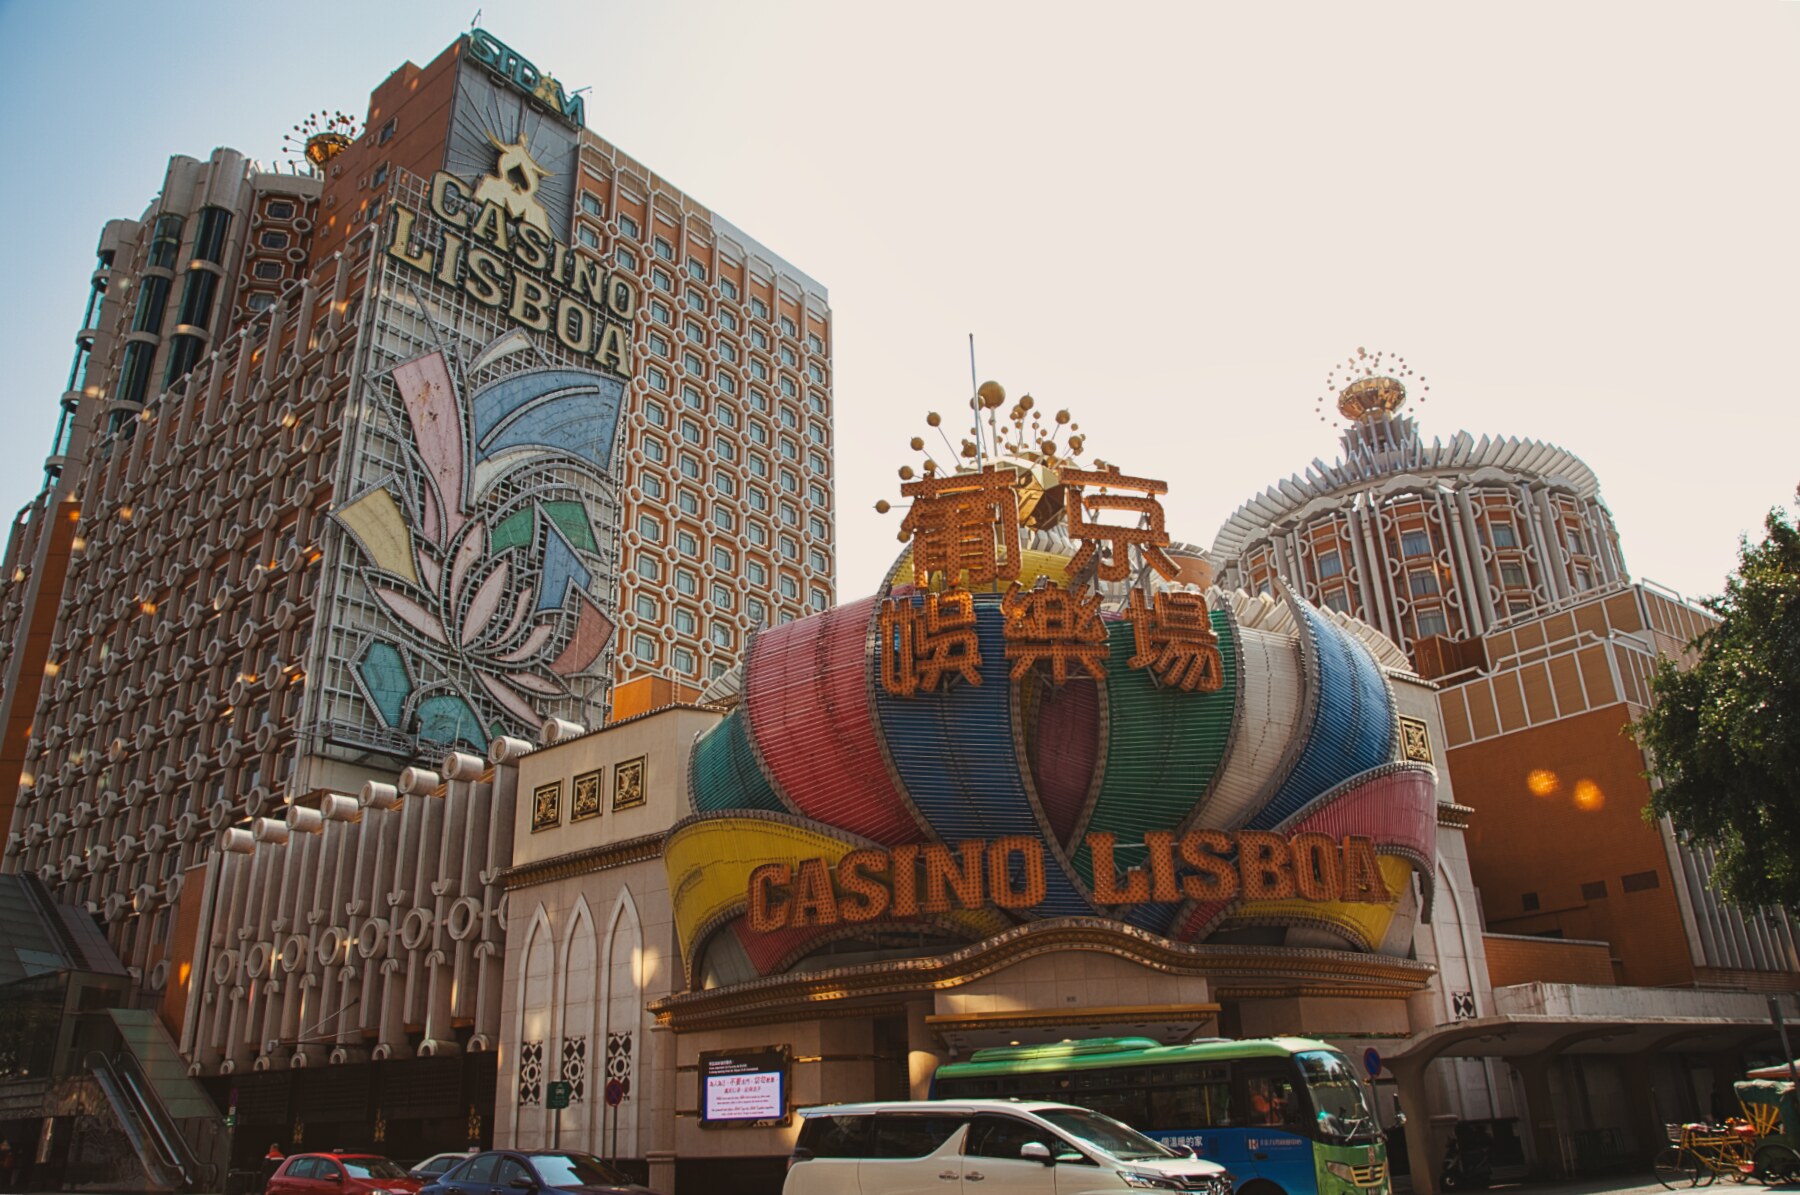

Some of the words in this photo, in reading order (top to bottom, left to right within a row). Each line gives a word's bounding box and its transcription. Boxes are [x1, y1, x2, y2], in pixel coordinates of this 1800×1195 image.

[386, 204, 633, 379] LISBOA
[430, 170, 638, 322] CASINO
[900, 464, 1182, 589] 葡京
[747, 835, 1047, 934] CASINO
[1086, 828, 1392, 905] LISBOA
